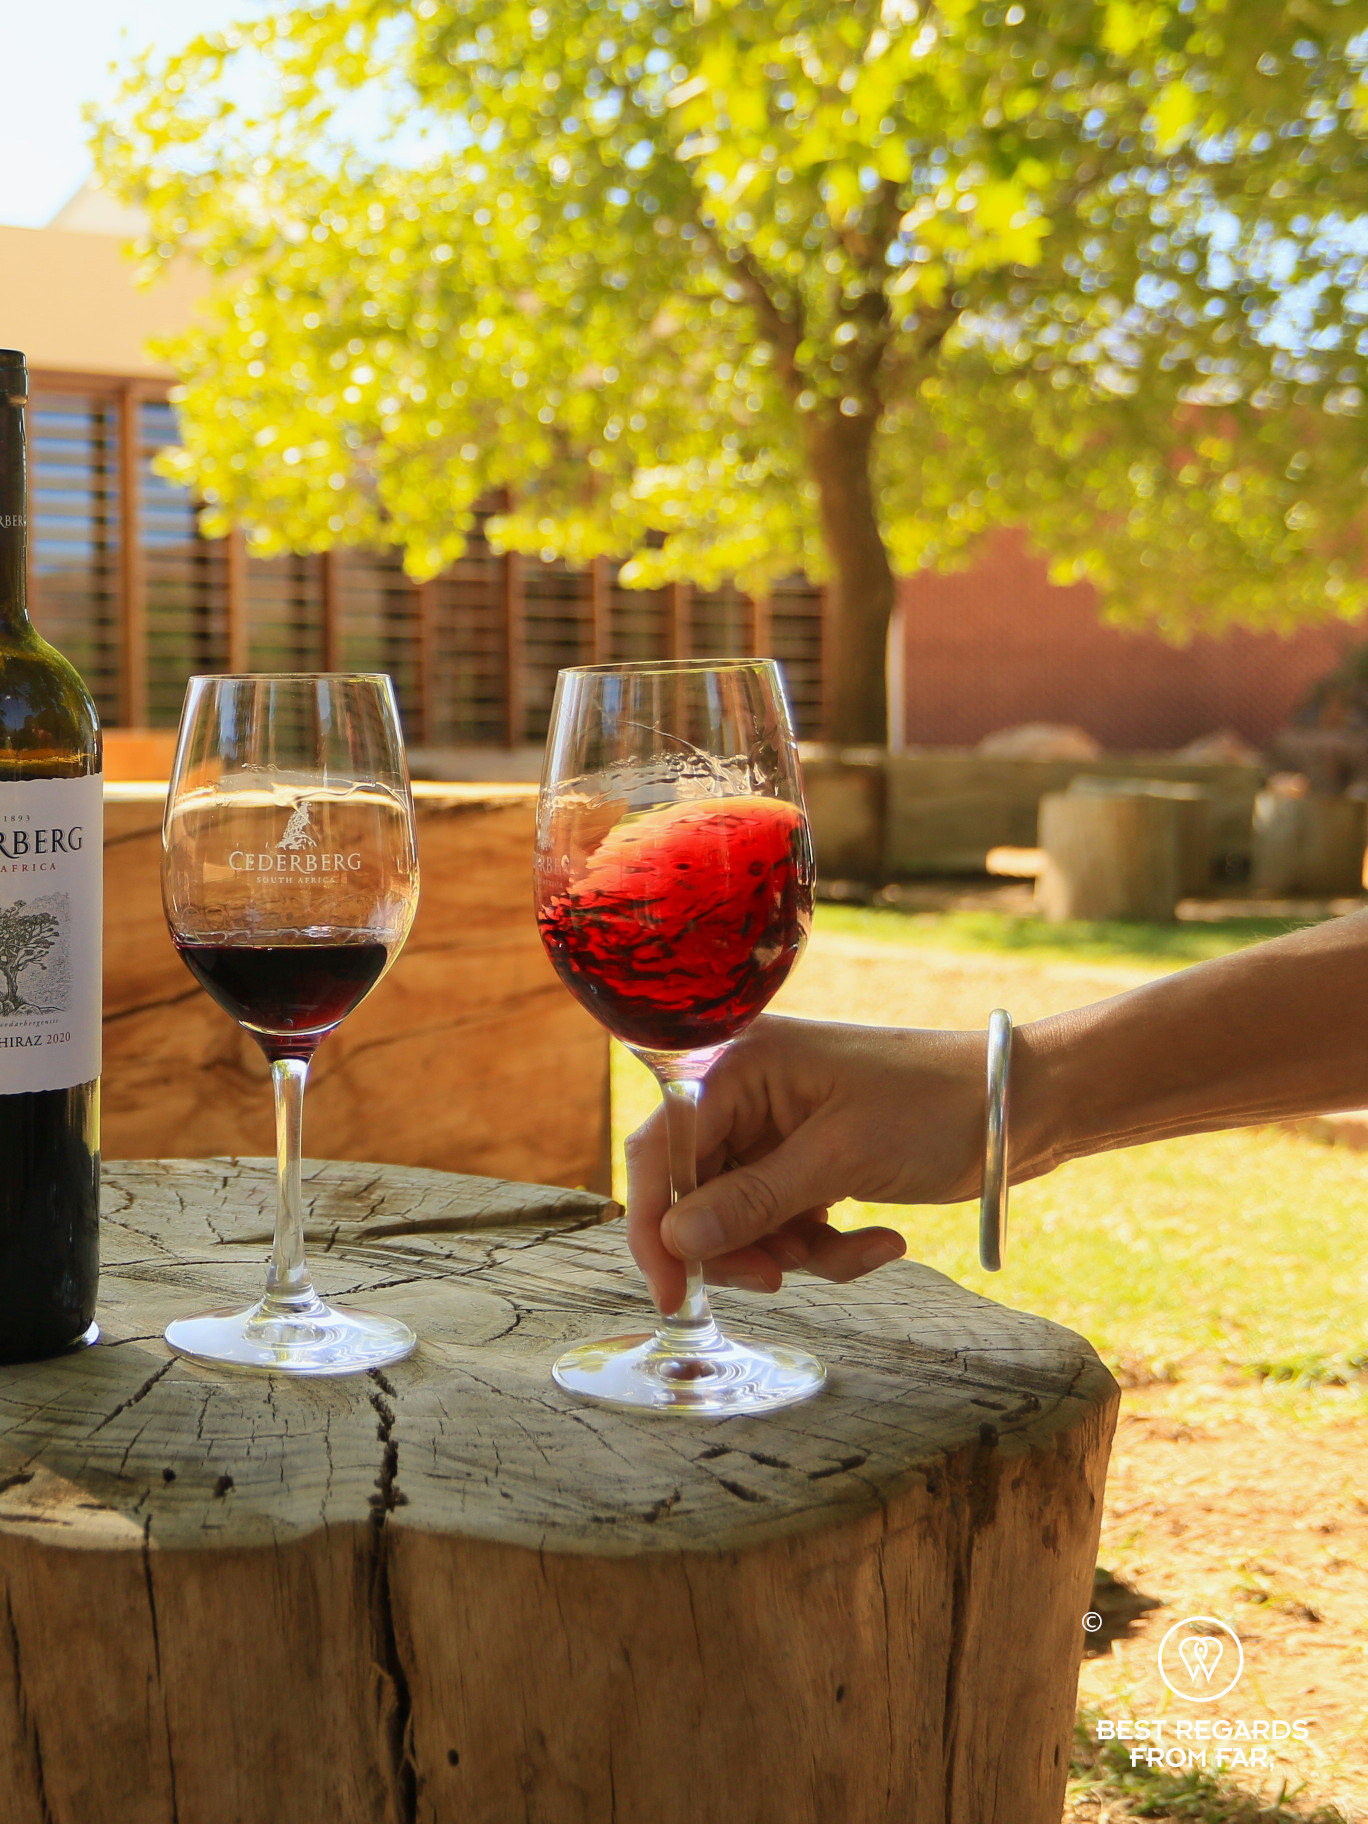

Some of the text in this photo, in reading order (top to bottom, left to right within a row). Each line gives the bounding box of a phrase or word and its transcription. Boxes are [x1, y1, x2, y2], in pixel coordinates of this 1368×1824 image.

[0, 862, 57, 873] AFRICA
[228, 850, 361, 874] CEDERBERG
[256, 876, 336, 884] SOUTH AFRICA
[46, 1031, 72, 1045] 2020
